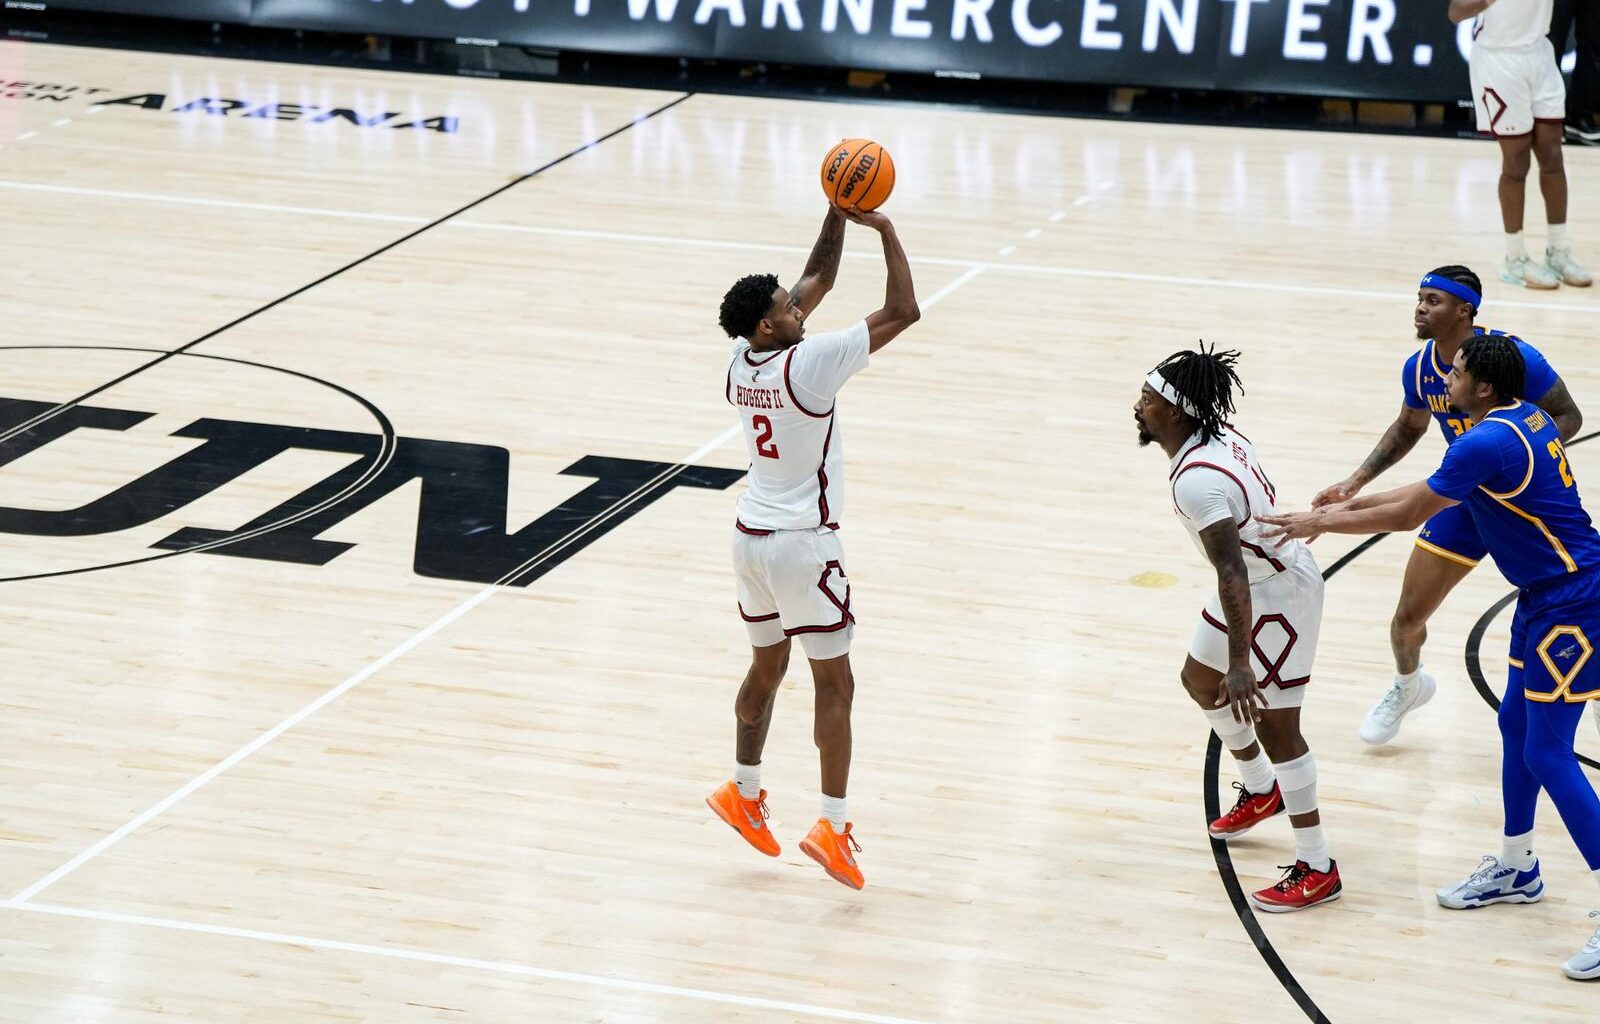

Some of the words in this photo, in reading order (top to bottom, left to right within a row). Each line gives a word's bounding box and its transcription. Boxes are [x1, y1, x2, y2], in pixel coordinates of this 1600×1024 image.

[89, 93, 458, 133] ARENA
[827, 149, 849, 183] NCAA
[841, 154, 876, 199] Wilson
[736, 384, 772, 409] HUGHES
[773, 388, 784, 409] II
[752, 414, 779, 459] 2
